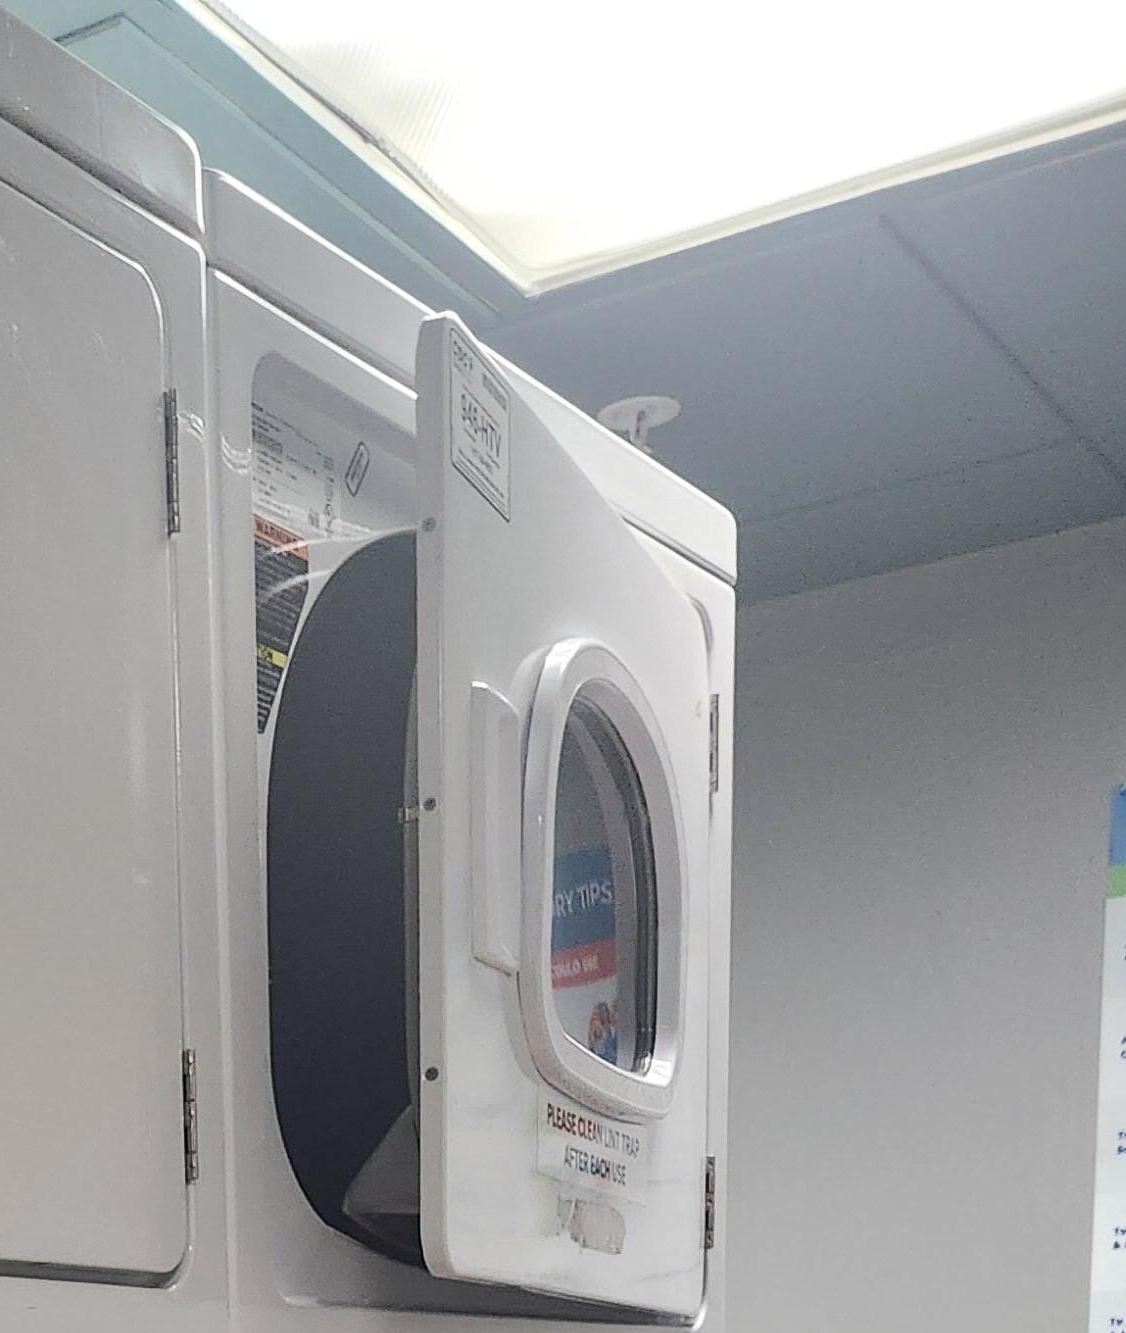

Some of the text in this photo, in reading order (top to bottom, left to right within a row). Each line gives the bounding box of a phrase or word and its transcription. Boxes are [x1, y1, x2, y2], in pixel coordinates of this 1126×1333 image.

[553, 881, 613, 917] RY TIPS
[547, 1103, 639, 1158] PLEASE CLEAN LINT TRAP
[563, 1143, 626, 1186] AFTER EACH USE
